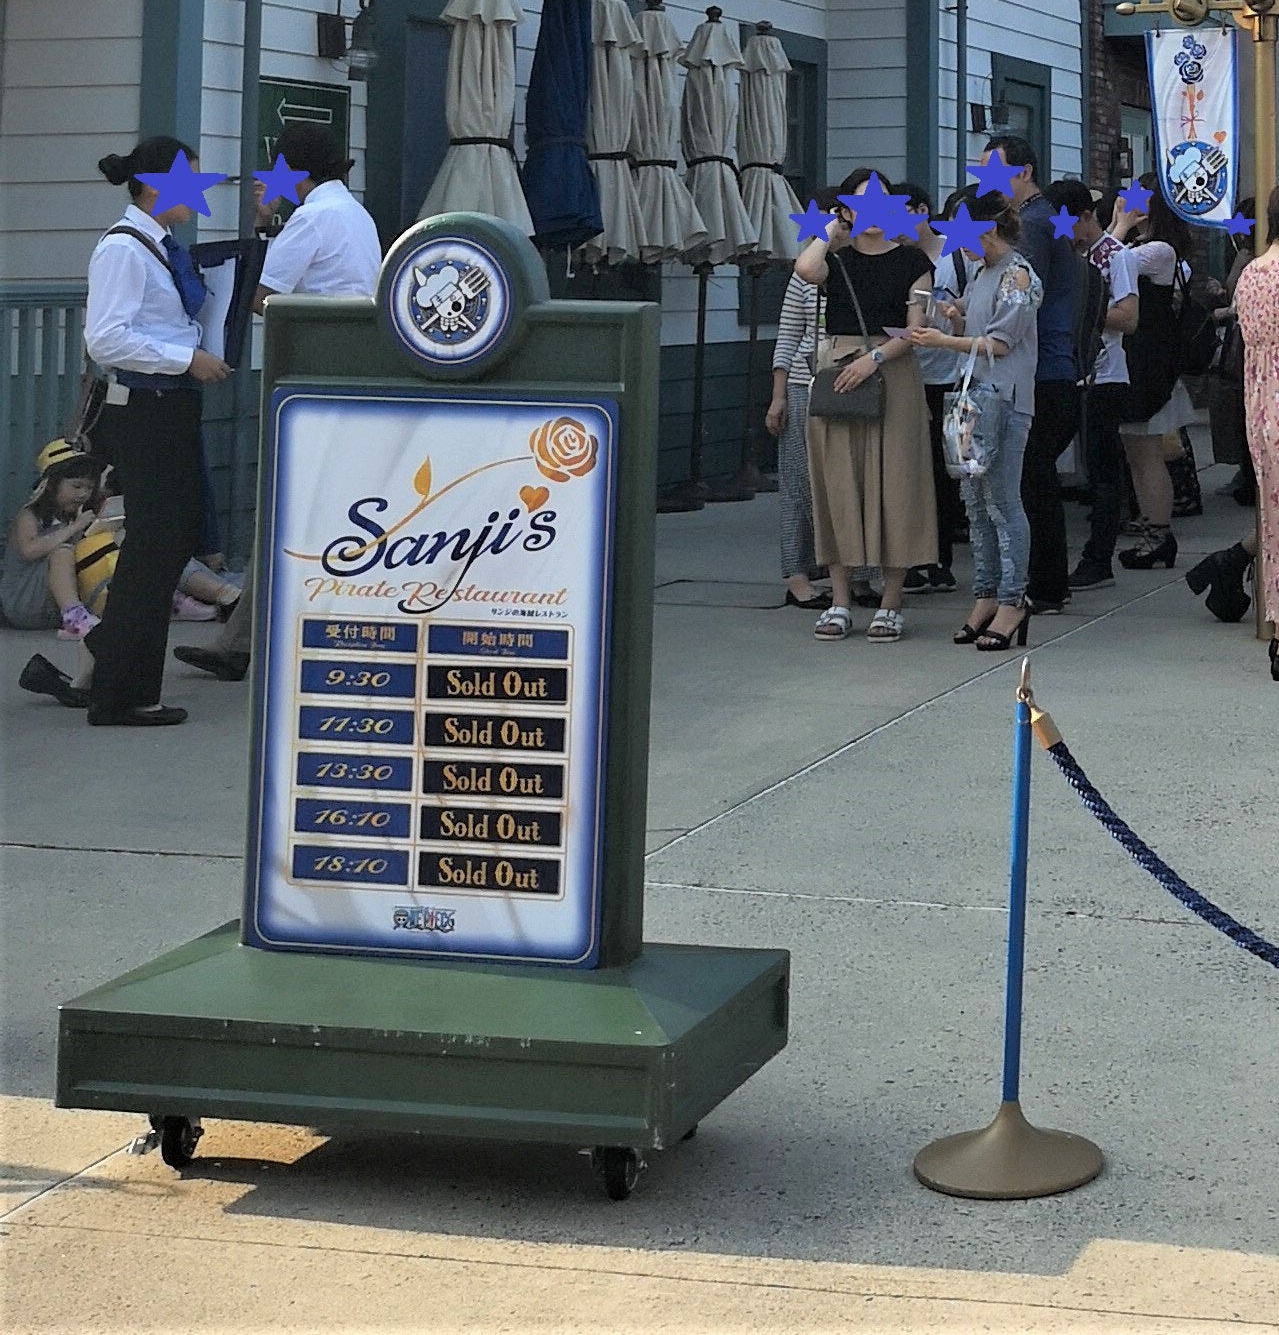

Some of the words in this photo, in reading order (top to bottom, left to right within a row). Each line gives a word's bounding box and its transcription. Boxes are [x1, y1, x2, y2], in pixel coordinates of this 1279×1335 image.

[304, 576, 398, 603] Pirate
[400, 579, 569, 607] Restaurant
[325, 623, 397, 642] 受付時間
[461, 631, 534, 649] 開始時間
[325, 669, 392, 689] 9:30
[446, 670, 496, 697] Sold
[502, 672, 549, 698] Out
[318, 716, 395, 735] 11:30
[444, 717, 493, 745] Sold
[500, 719, 546, 748] Out
[316, 762, 394, 781] 13:30
[442, 764, 492, 793] Sold
[499, 766, 545, 795] Out
[313, 808, 391, 828] 16:10
[440, 811, 490, 839] Sold
[495, 813, 542, 842] Out
[312, 855, 389, 875] 18:10
[438, 857, 488, 885] Sold
[494, 860, 540, 889] Out
